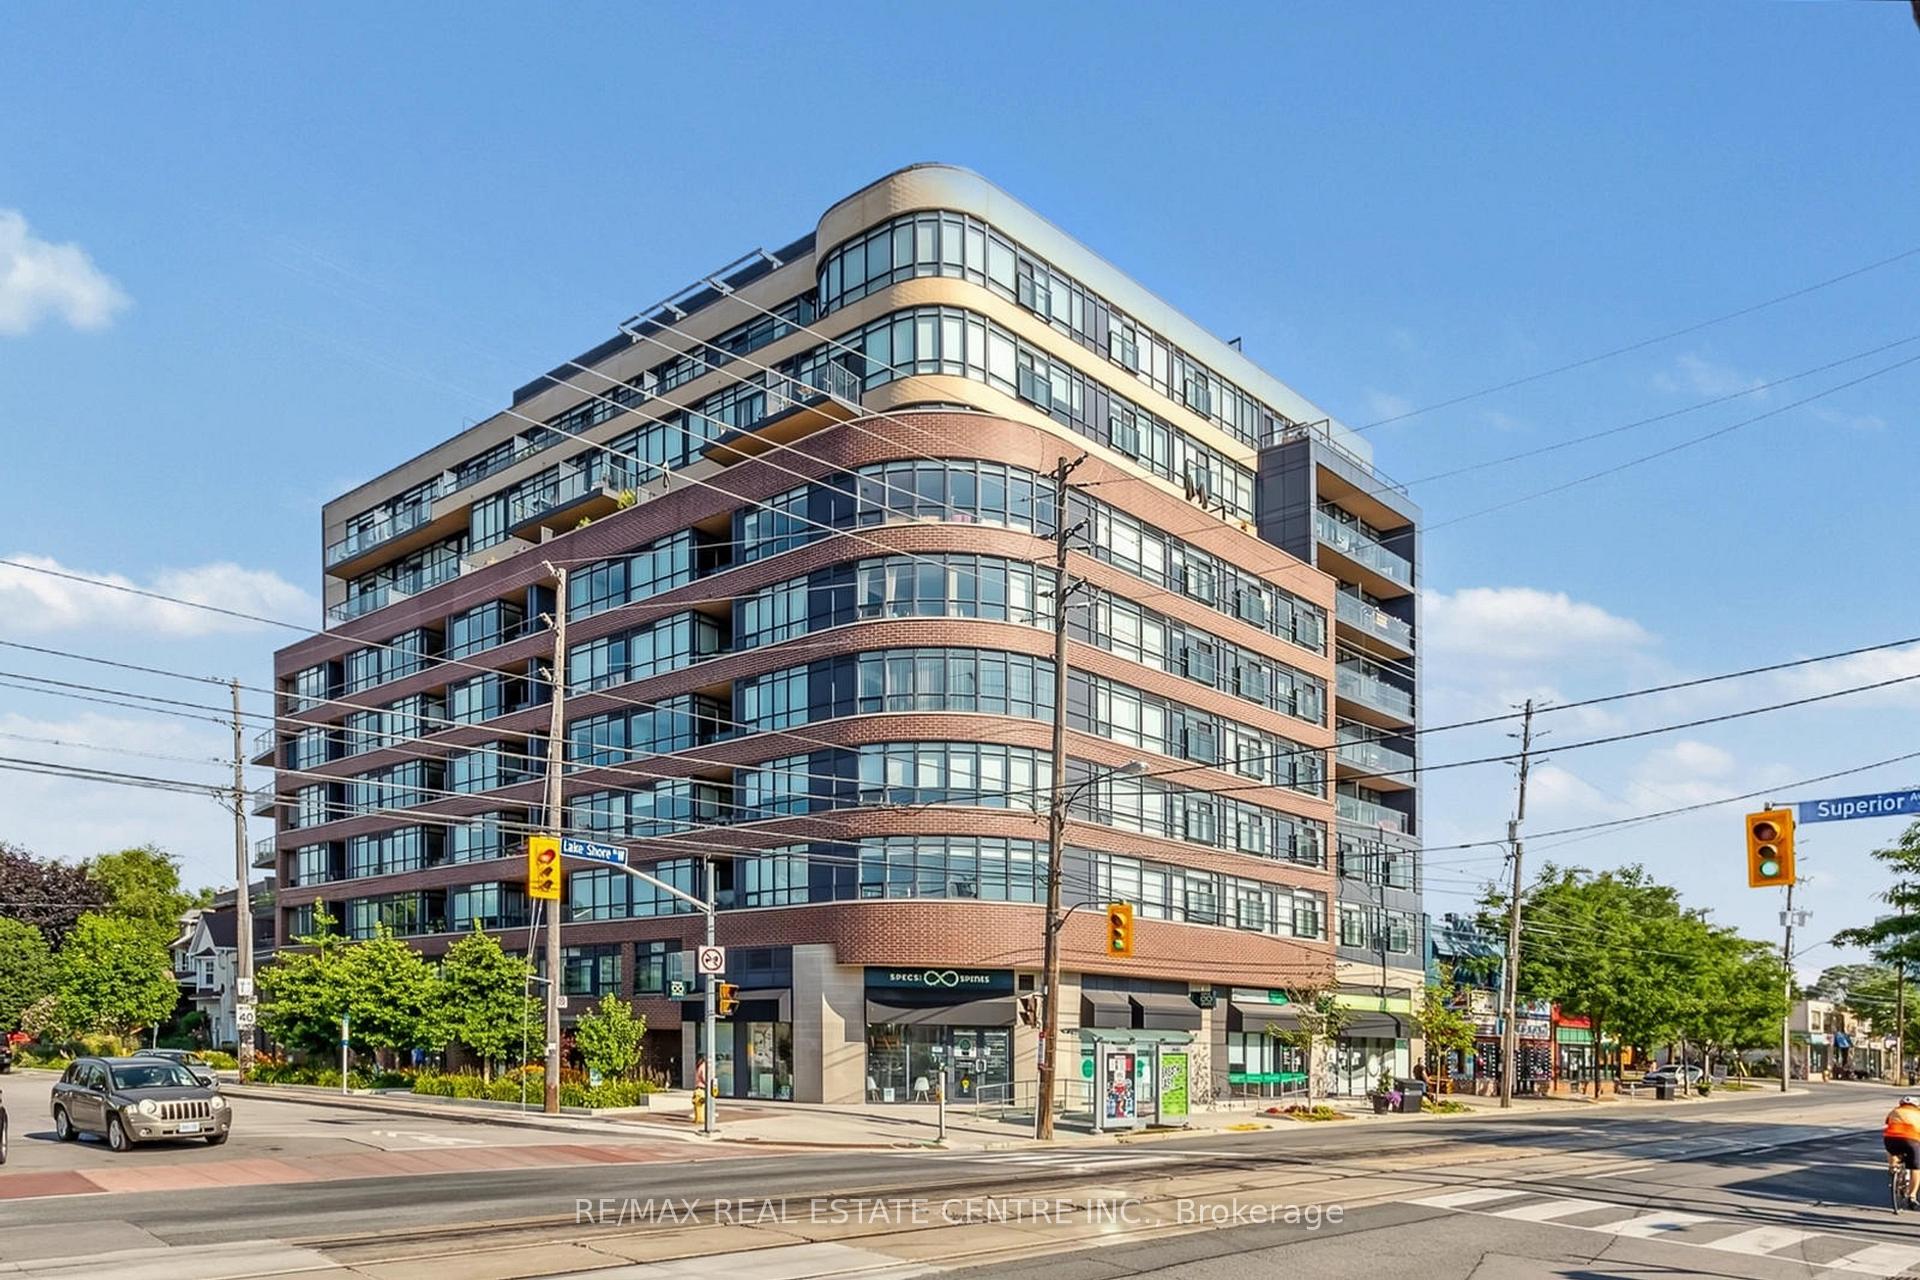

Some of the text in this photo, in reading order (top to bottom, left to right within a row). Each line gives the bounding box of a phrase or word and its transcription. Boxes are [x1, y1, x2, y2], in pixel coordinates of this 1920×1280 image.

[1818, 796, 1905, 818] Superior
[563, 839, 584, 855] Lake
[586, 844, 611, 860] Shore
[889, 973, 919, 981] SPECS
[239, 1012, 254, 1022] 40
